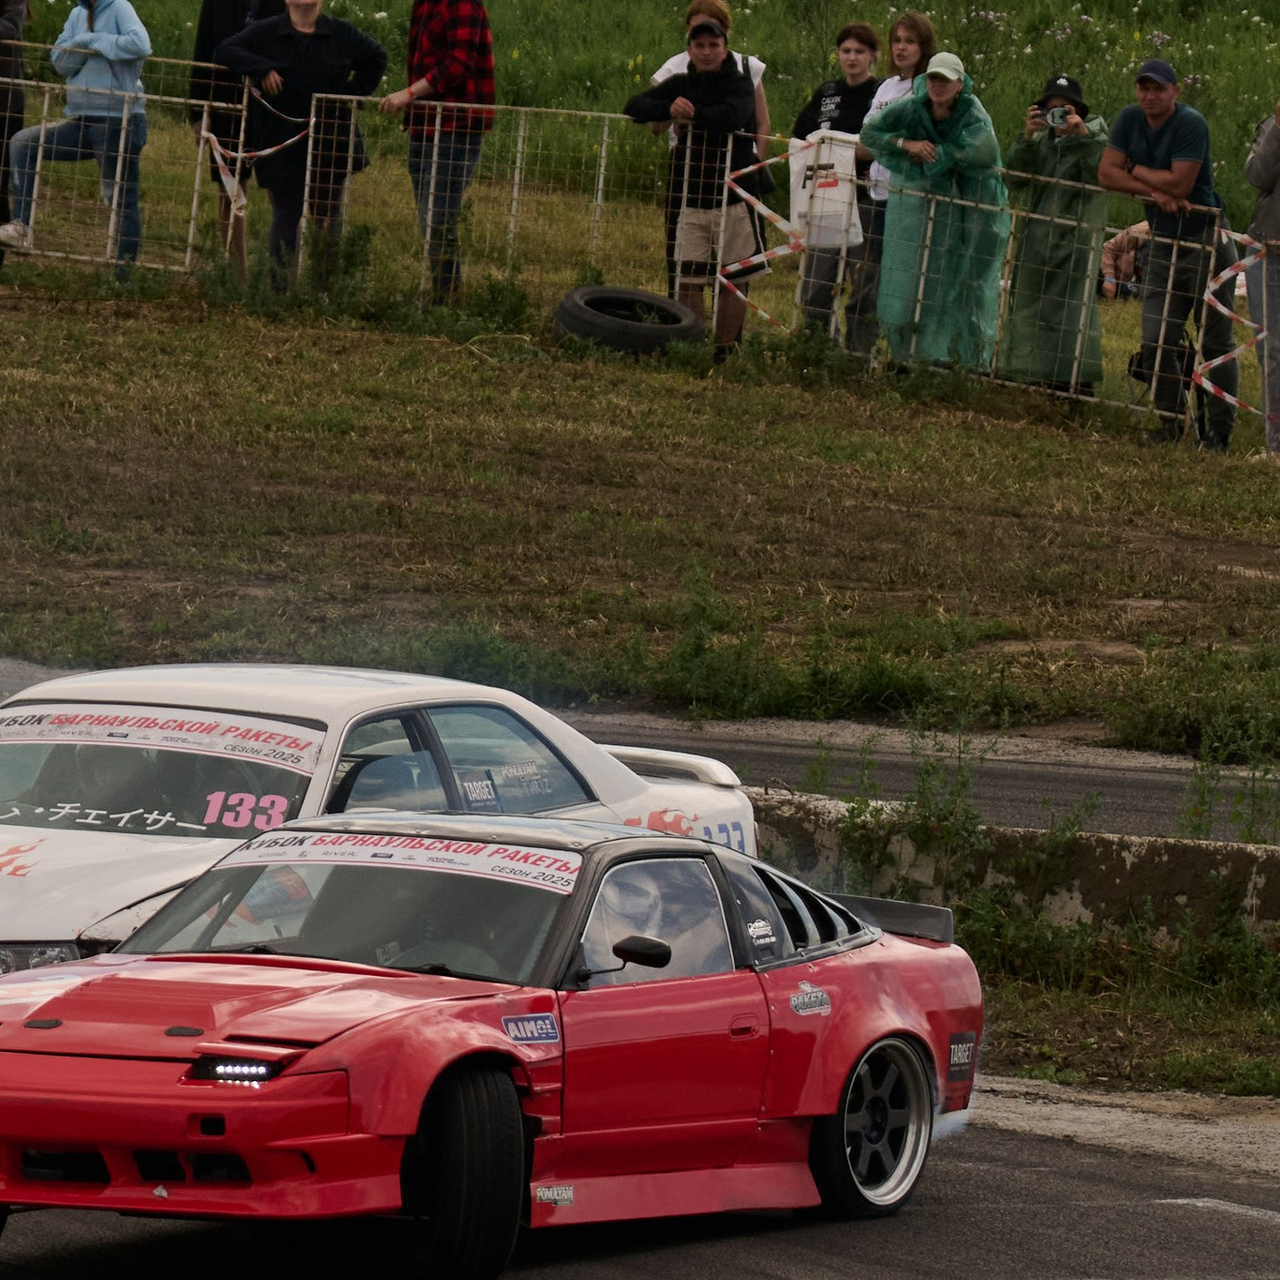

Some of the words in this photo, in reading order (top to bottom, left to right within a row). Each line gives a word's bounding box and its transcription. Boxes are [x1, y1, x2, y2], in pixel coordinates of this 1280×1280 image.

[48, 713, 219, 735] БАРНАУЛЬСКОЙ
[221, 725, 313, 751] РАКЕТЫ
[224, 743, 262, 755] СЕЗОН
[263, 749, 305, 765] 2025
[463, 780, 495, 800] TARGET
[203, 791, 288, 831] 133
[239, 835, 313, 852] КУБОК
[311, 835, 488, 856] БАРНАУЛЬСКОЙ
[488, 844, 582, 874] РАКЕТЫ
[491, 865, 531, 877] СЕЗОН
[531, 872, 574, 887] 2025
[508, 1020, 556, 1038] AIMOL
[951, 1043, 974, 1064] TARGET
